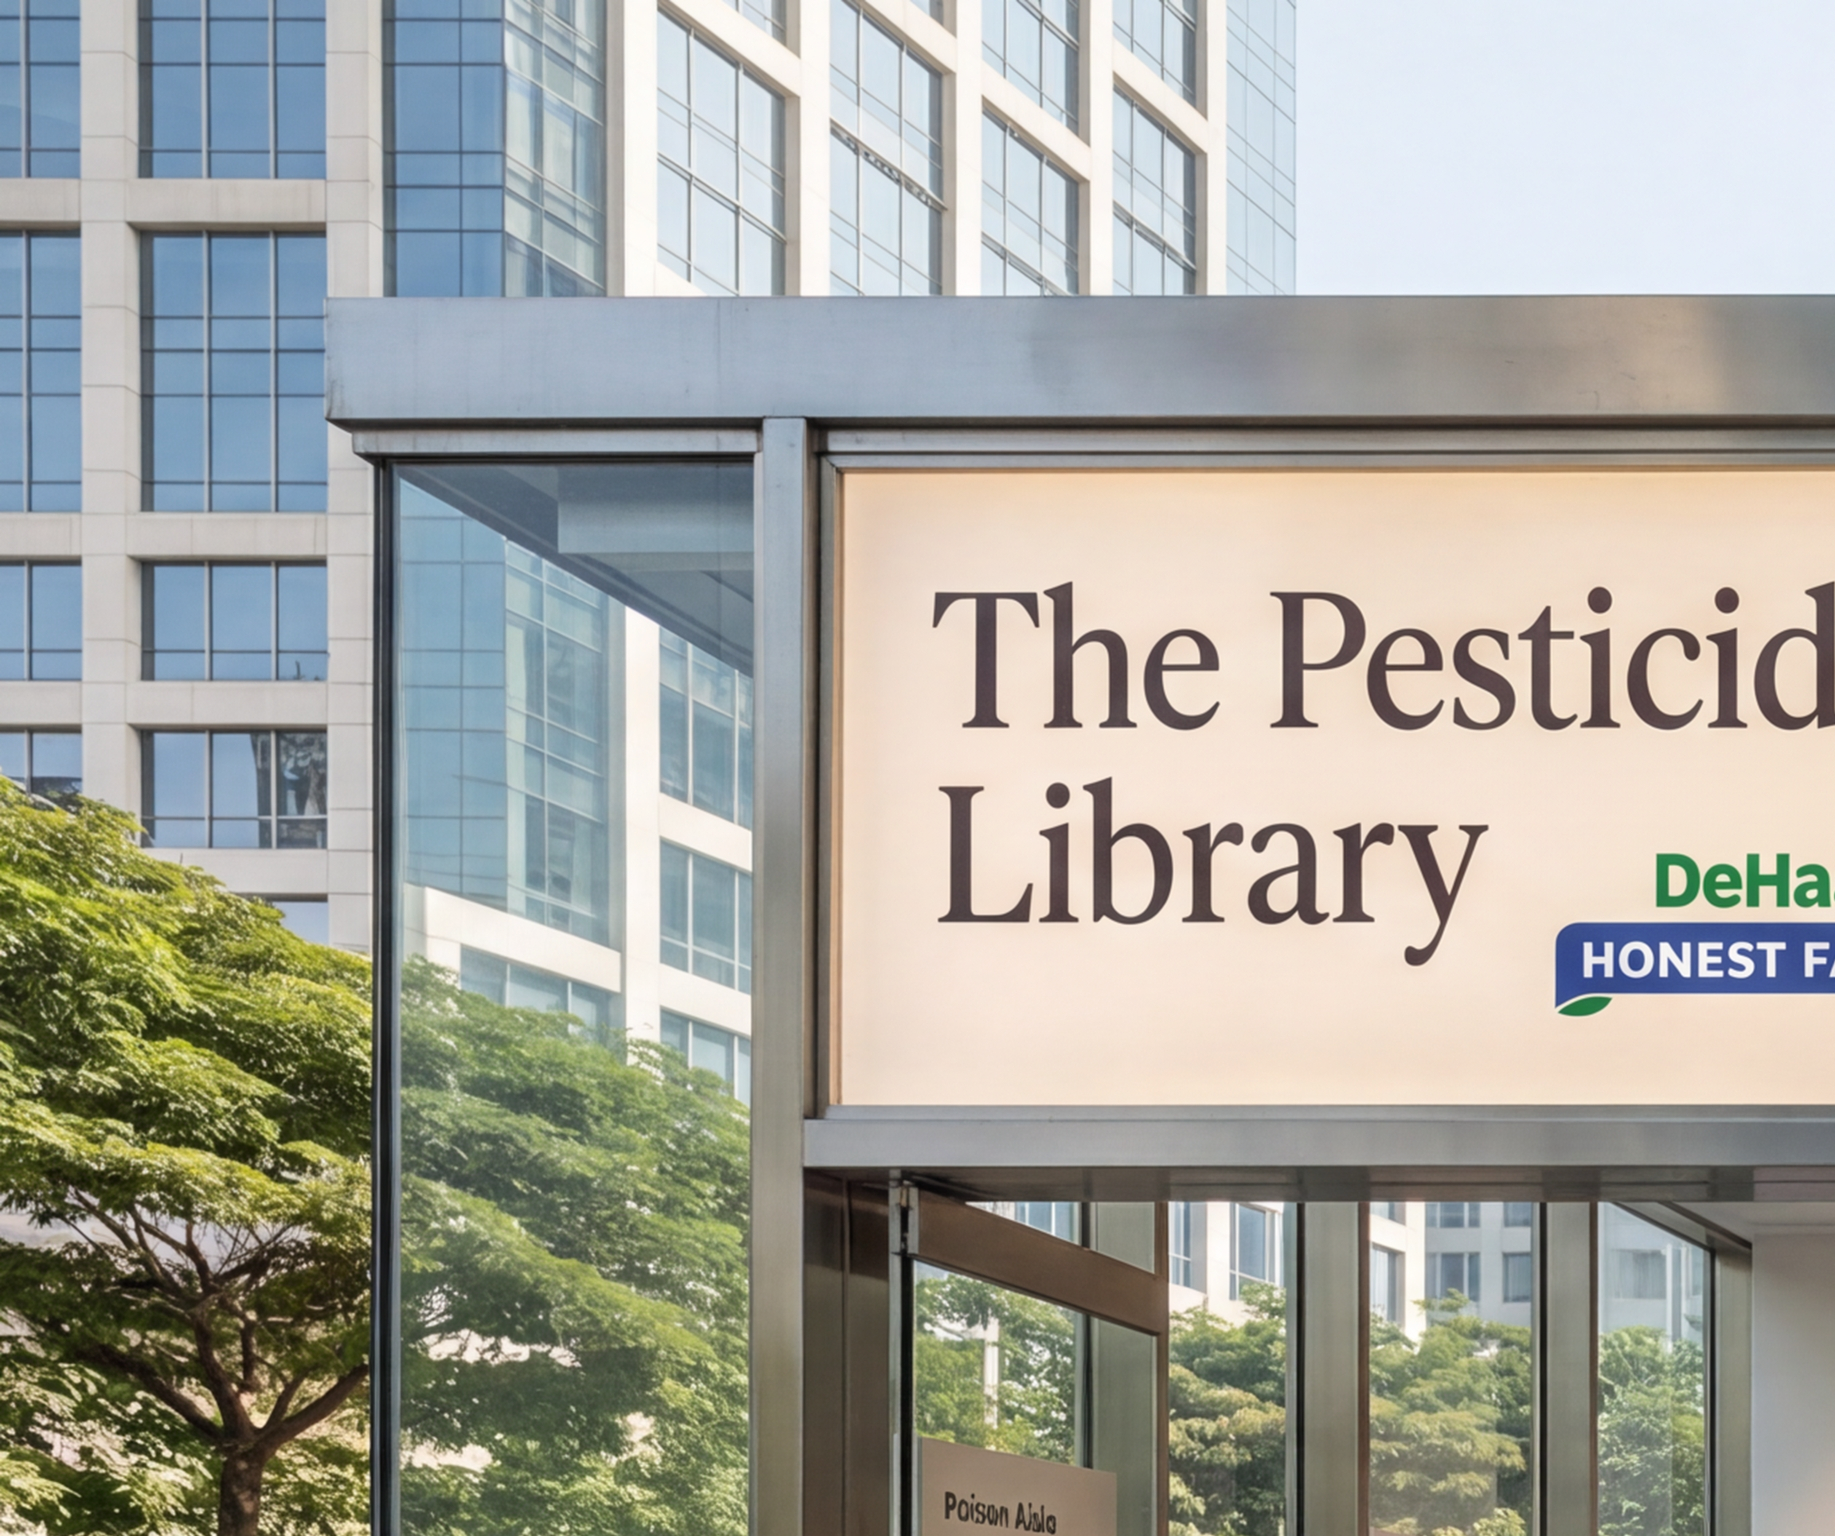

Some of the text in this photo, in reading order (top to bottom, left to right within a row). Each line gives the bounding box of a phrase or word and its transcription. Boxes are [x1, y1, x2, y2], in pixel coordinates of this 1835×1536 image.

[932, 581, 1221, 731] The
[937, 775, 1489, 966] Library
[1581, 940, 1787, 979] HONEST
[944, 1490, 1009, 1529] Poison
